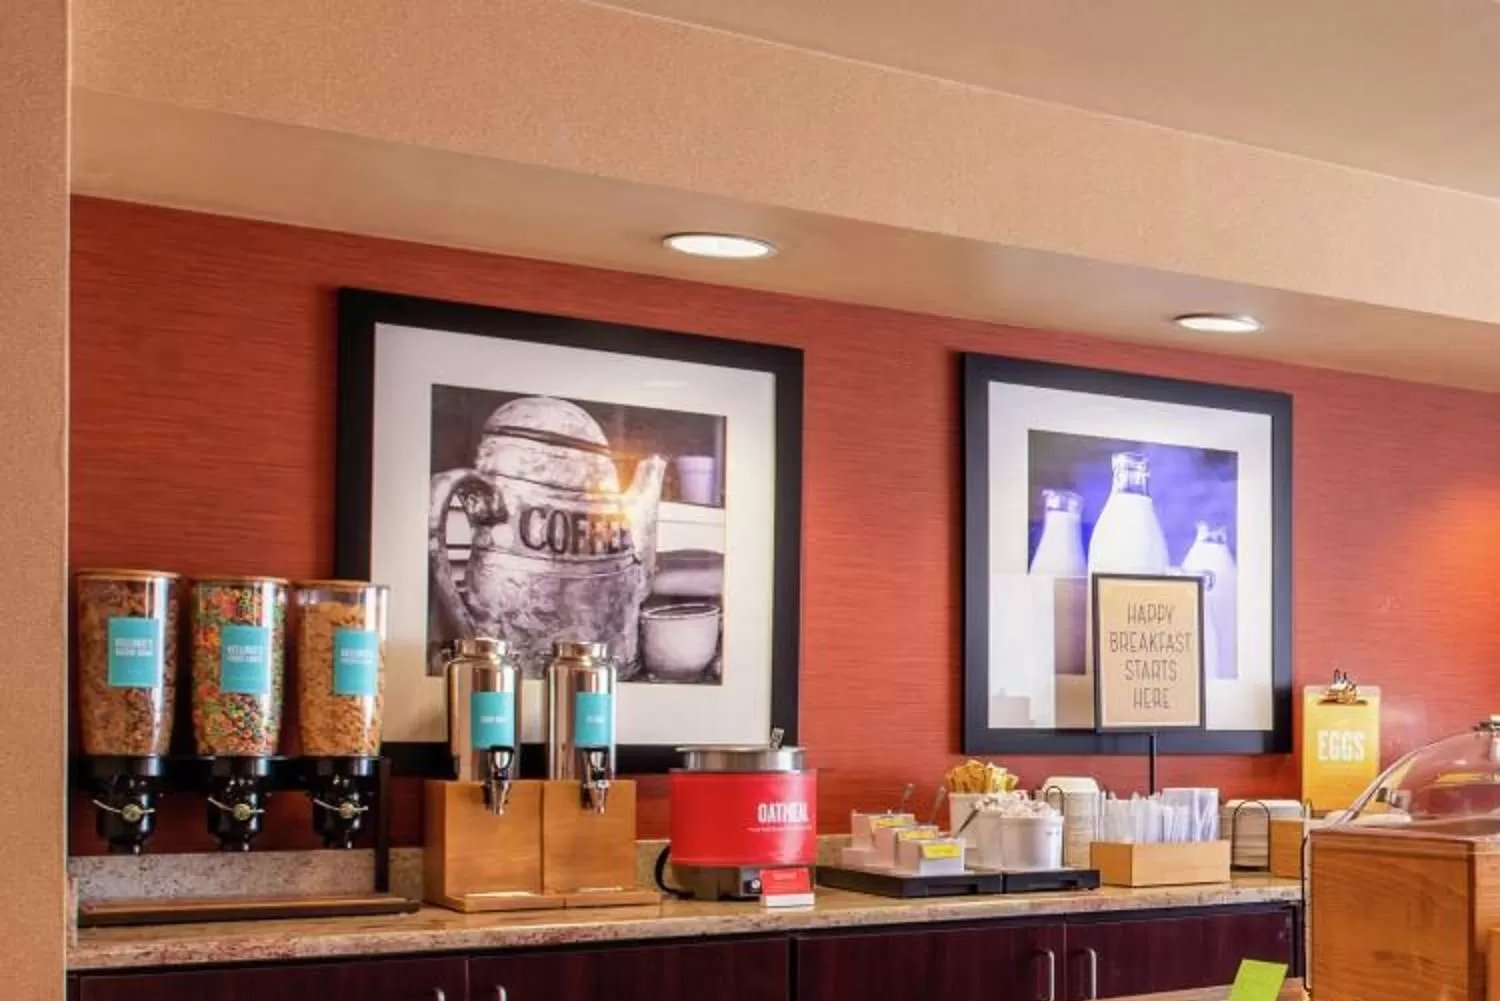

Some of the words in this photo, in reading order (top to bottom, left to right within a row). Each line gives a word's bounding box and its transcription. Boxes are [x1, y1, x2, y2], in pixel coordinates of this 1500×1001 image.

[1127, 603, 1175, 625] HAPPY
[1109, 631, 1192, 653] BREAKFAST
[1124, 659, 1177, 681] STARTS
[1133, 687, 1171, 709] HERE
[1317, 730, 1365, 762] EGGS
[757, 802, 809, 823] OATMEAL
